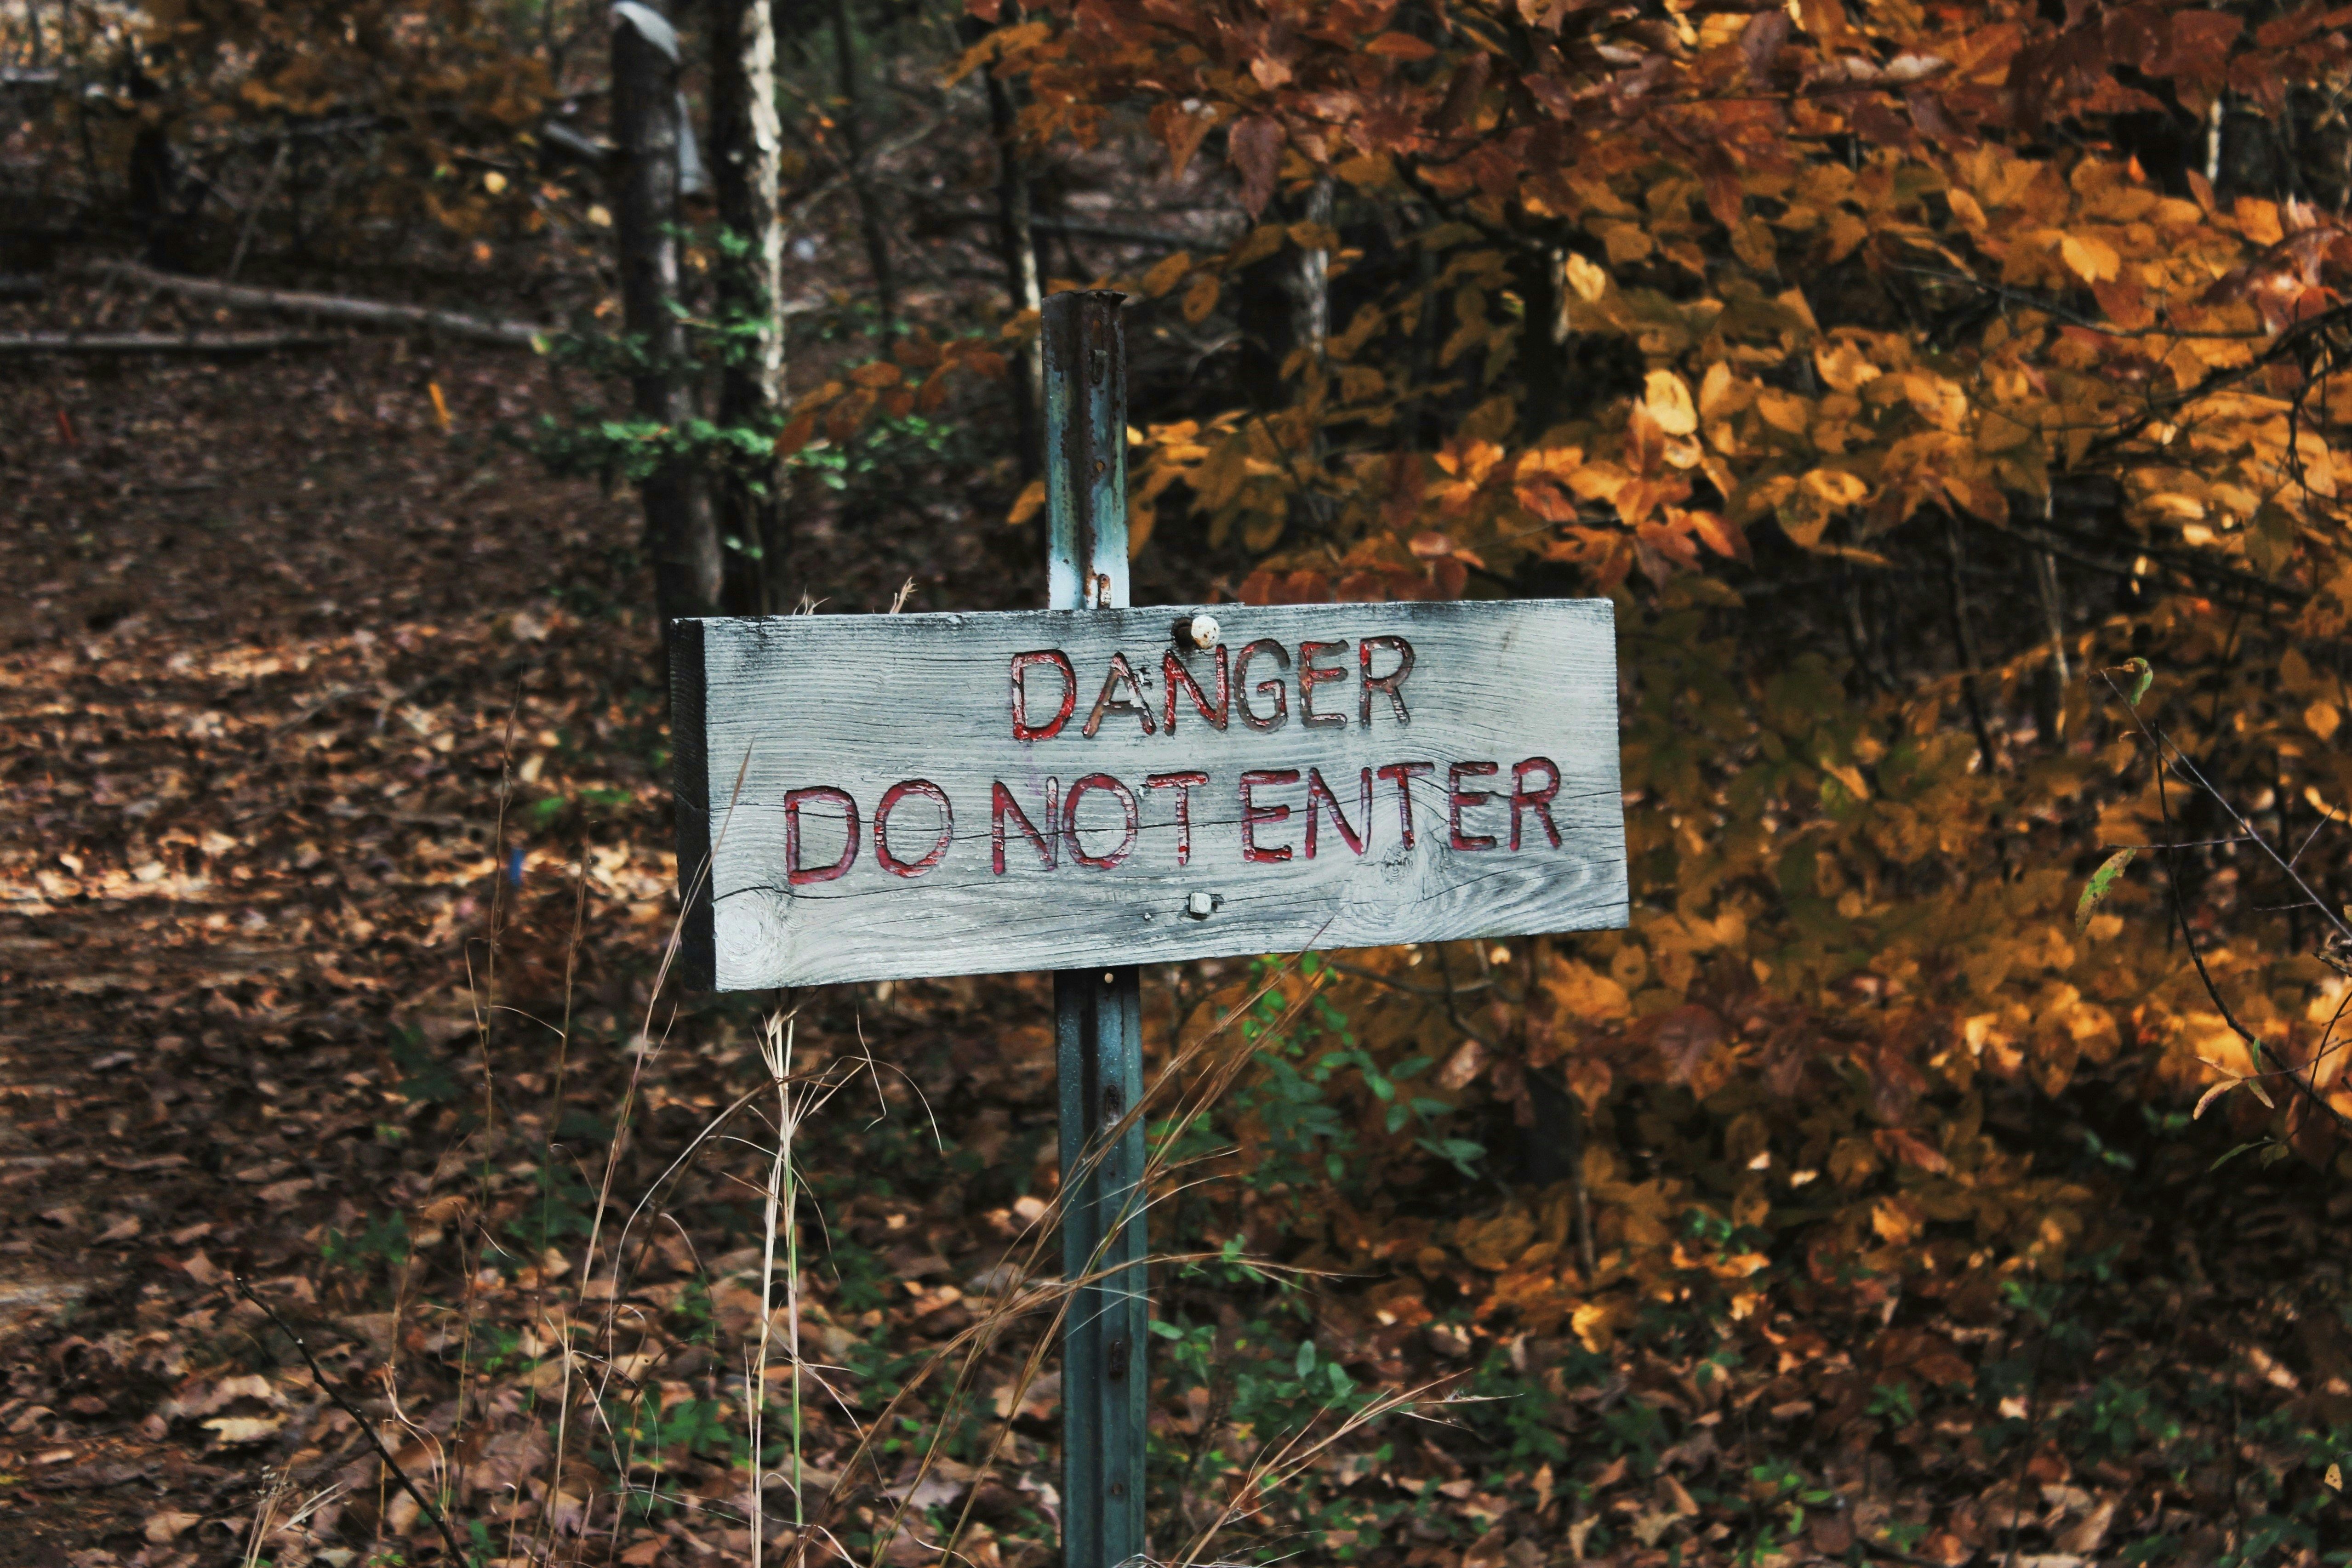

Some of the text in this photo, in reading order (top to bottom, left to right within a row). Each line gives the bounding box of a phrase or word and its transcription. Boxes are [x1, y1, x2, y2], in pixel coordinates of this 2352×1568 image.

[1011, 635, 1414, 741] DANGER
[784, 756, 1562, 884] DO NOT ENTER
